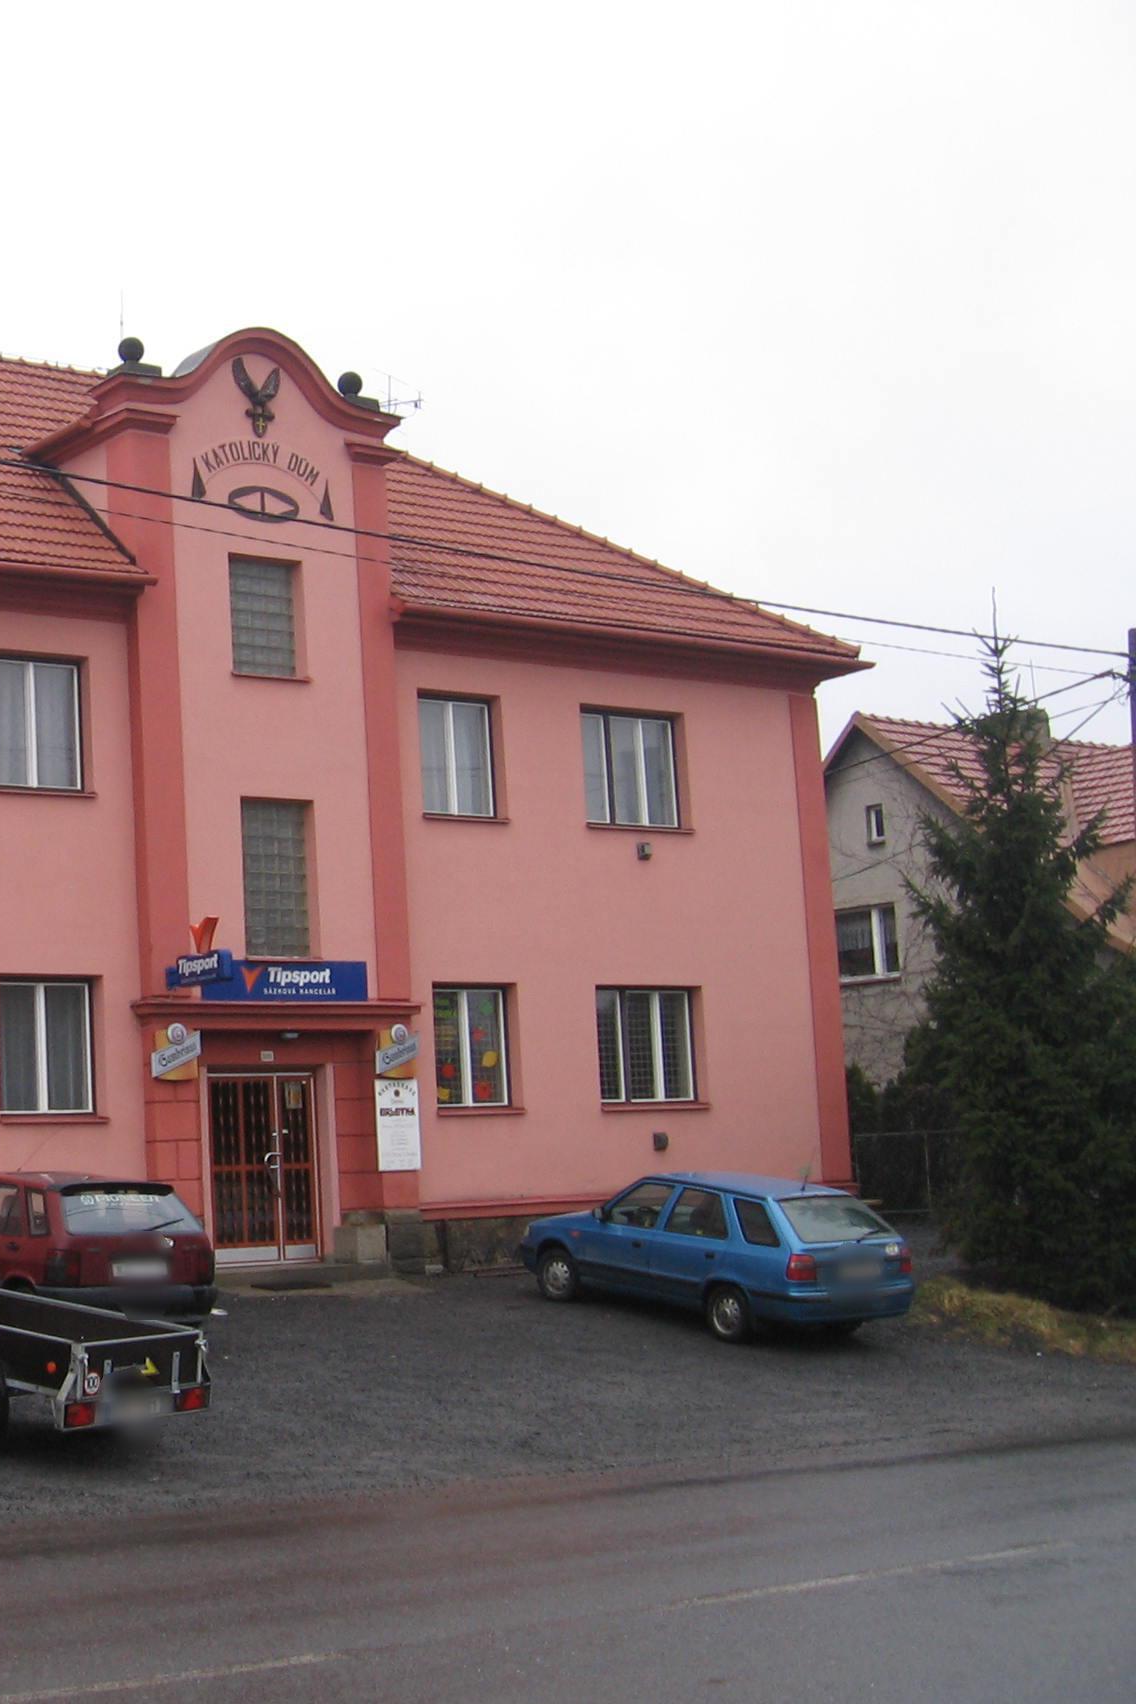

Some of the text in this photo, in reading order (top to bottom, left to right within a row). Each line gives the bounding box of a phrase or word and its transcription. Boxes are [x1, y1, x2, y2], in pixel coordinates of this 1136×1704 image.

[201, 440, 280, 473] KATOLICKÝ
[178, 954, 218, 976] Tipsport
[267, 967, 331, 987] Tipsport
